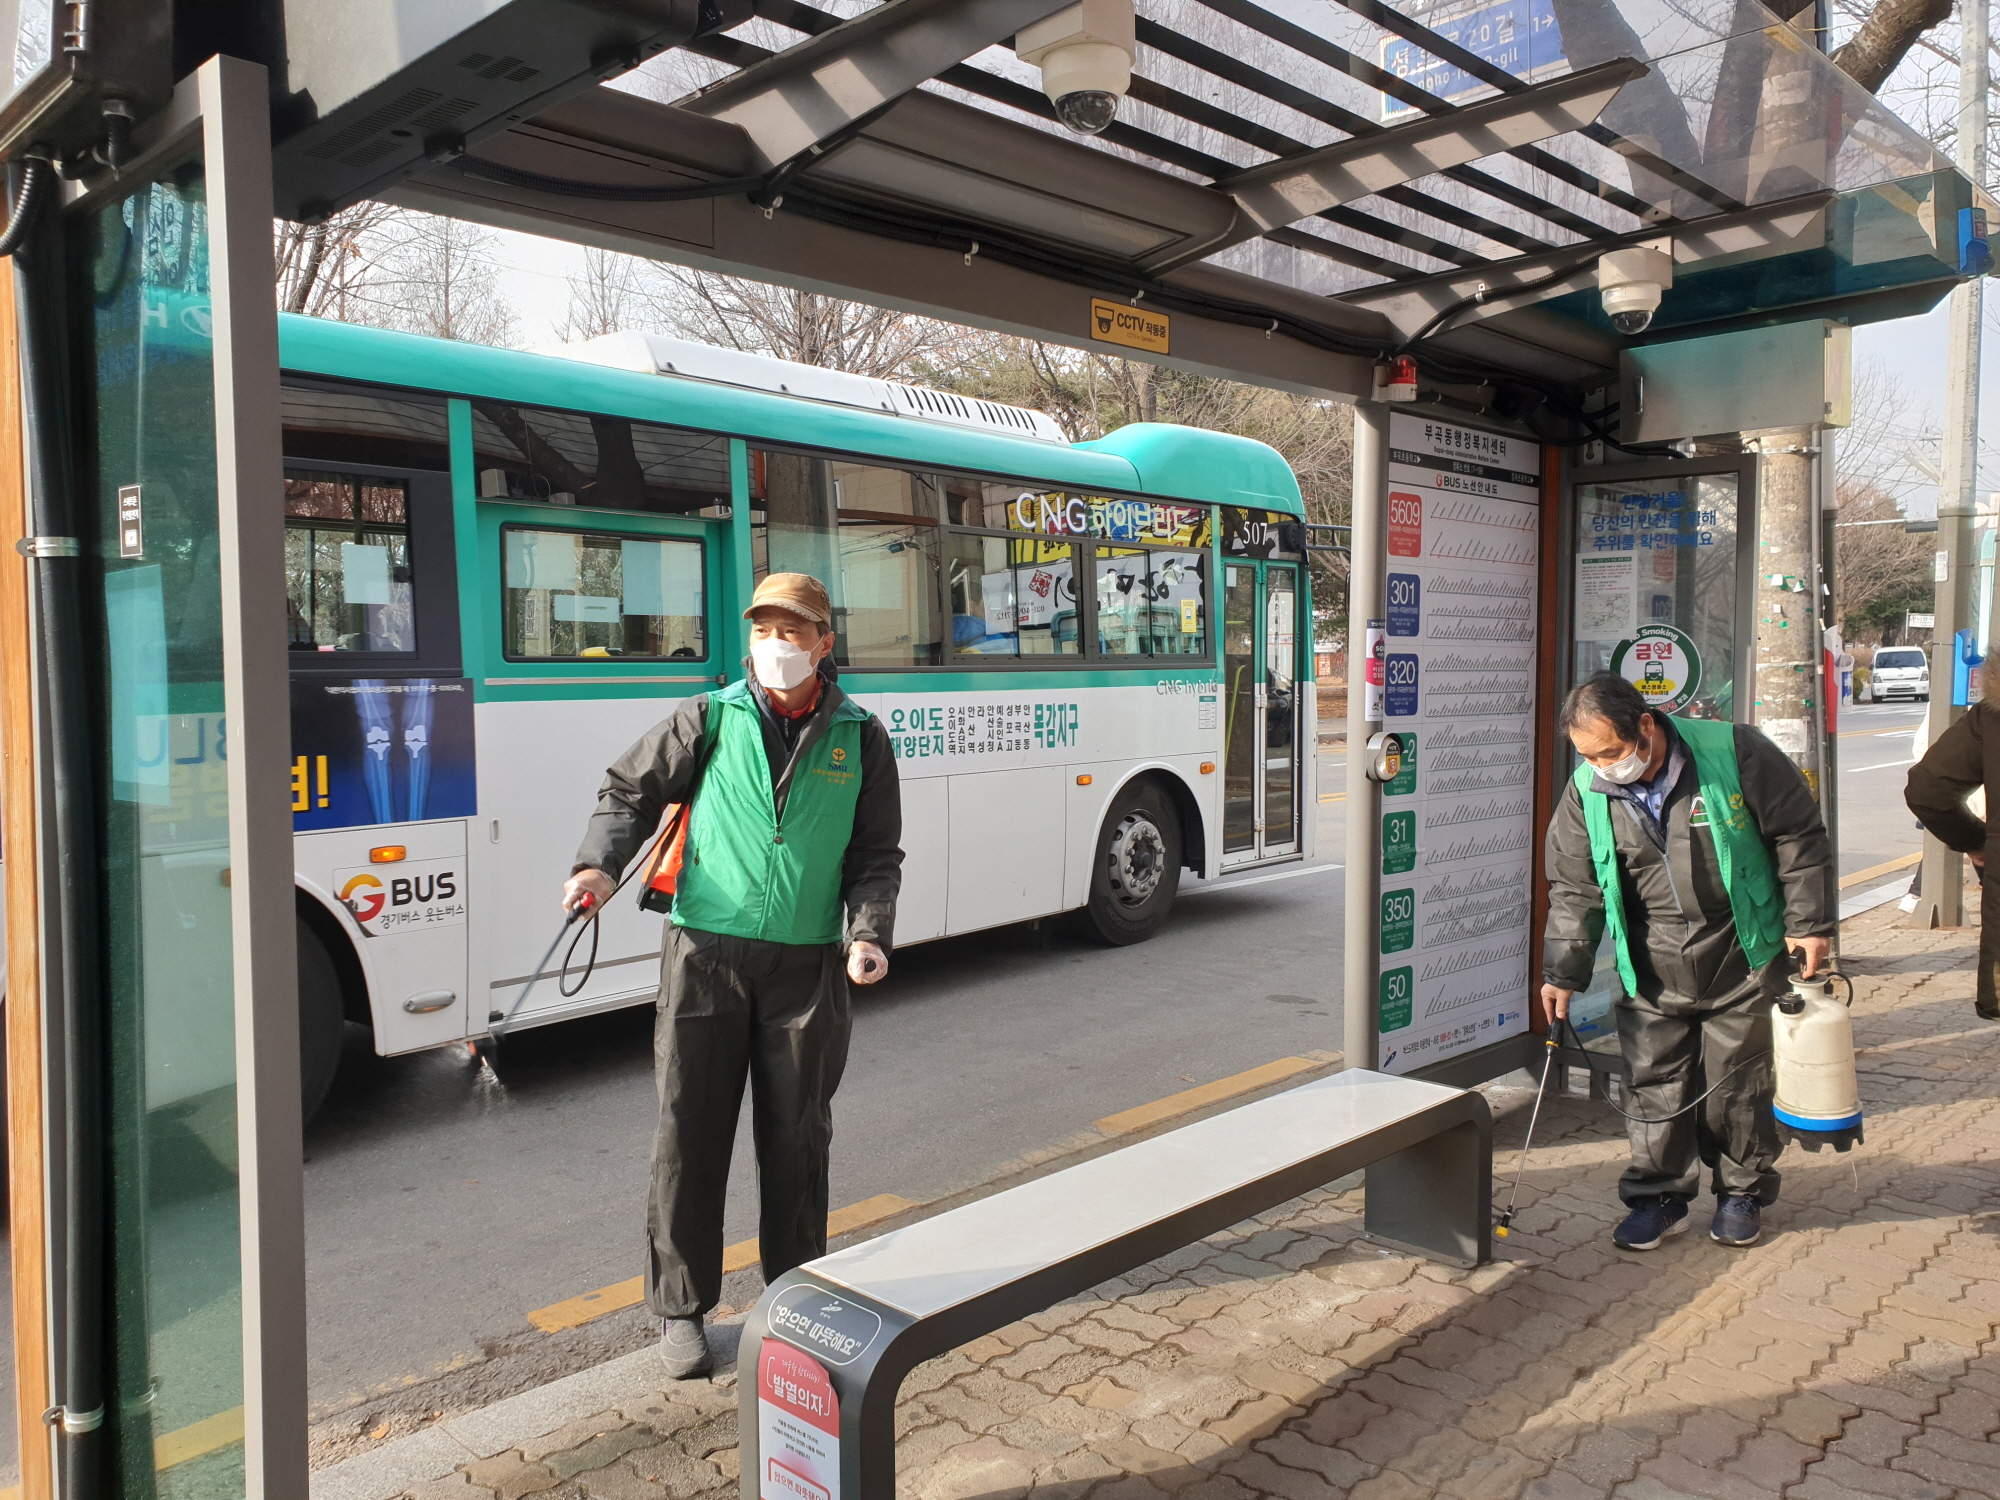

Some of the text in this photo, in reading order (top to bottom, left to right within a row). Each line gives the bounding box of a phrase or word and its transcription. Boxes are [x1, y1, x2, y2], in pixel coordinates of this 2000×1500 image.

[1117, 312, 1166, 338] CCTV 작동중
[1424, 423, 1507, 458] 부곡동행정복지센터
[1443, 475, 1460, 488] BUS
[1462, 479, 1498, 494] 노선안내도
[1016, 492, 1191, 542] CNG 하이브리드
[1391, 499, 1420, 526] 5609
[1592, 514, 1634, 532] 당신의
[1638, 511, 1681, 529] 안전을
[1243, 521, 1268, 545] 507
[1593, 534, 1635, 551] 주위를
[1391, 580, 1415, 605] 301
[1641, 628, 1679, 642] Smoking
[1636, 643, 1672, 660] 금연
[1389, 661, 1415, 684] 320
[1157, 679, 1218, 697] CNG hybrid
[889, 707, 944, 733] 오이도
[948, 707, 956, 755] 오이도역
[1034, 703, 1078, 748] 목감지구
[1390, 818, 1406, 843] 31
[392, 871, 456, 907] BUS
[381, 911, 421, 929] 경기버스
[1385, 895, 1411, 922] 350
[1388, 974, 1405, 1000] 50
[773, 1373, 823, 1416] 발열의자
[774, 1471, 794, 1492] 앉으면
